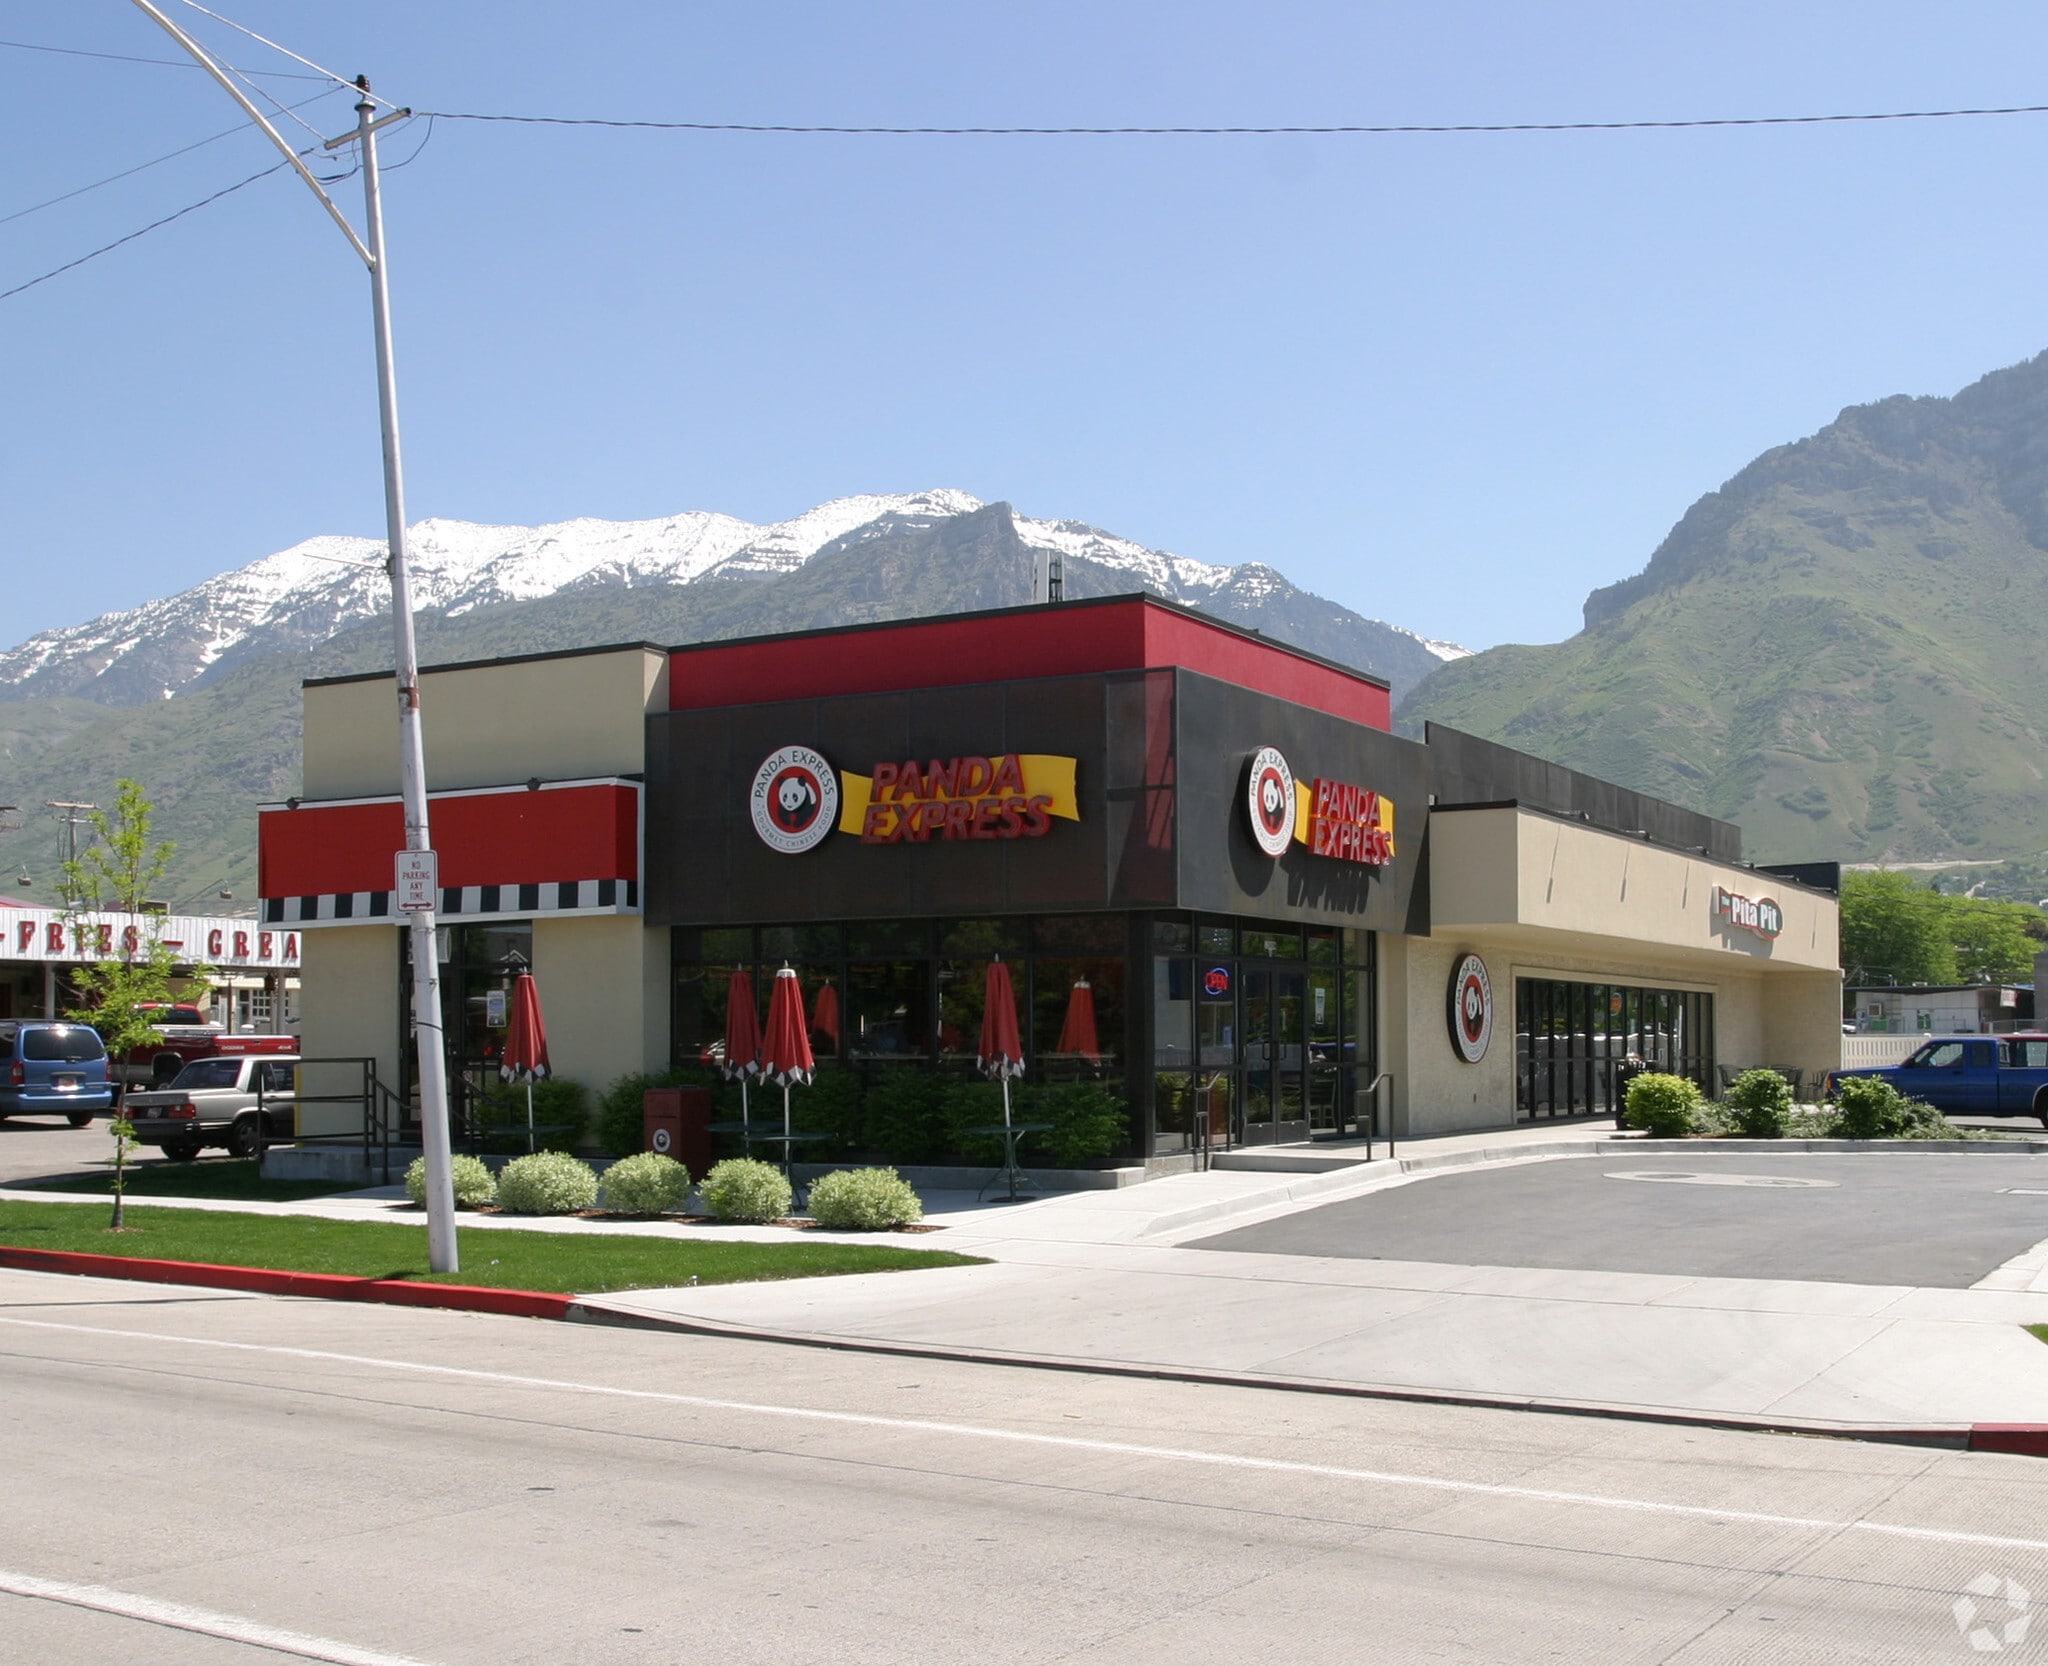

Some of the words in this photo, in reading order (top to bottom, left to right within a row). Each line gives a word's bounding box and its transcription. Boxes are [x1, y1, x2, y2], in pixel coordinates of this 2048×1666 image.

[755, 755, 787, 798] PANDA
[792, 751, 834, 795] EXPRESS
[869, 754, 1025, 802] PANDA
[860, 795, 1053, 844] EXPRESS
[1314, 778, 1381, 826] PANDA
[1311, 817, 1391, 866] EXPRESS
[402, 871, 430, 880] PARKING
[411, 861, 421, 870] NO
[410, 882, 423, 890] ANY
[1731, 895, 1758, 926] Pita
[1760, 904, 1777, 931] Pit
[19, 920, 139, 952] FRIES
[208, 929, 299, 959] GREA
[1204, 971, 1228, 990] OPEN
